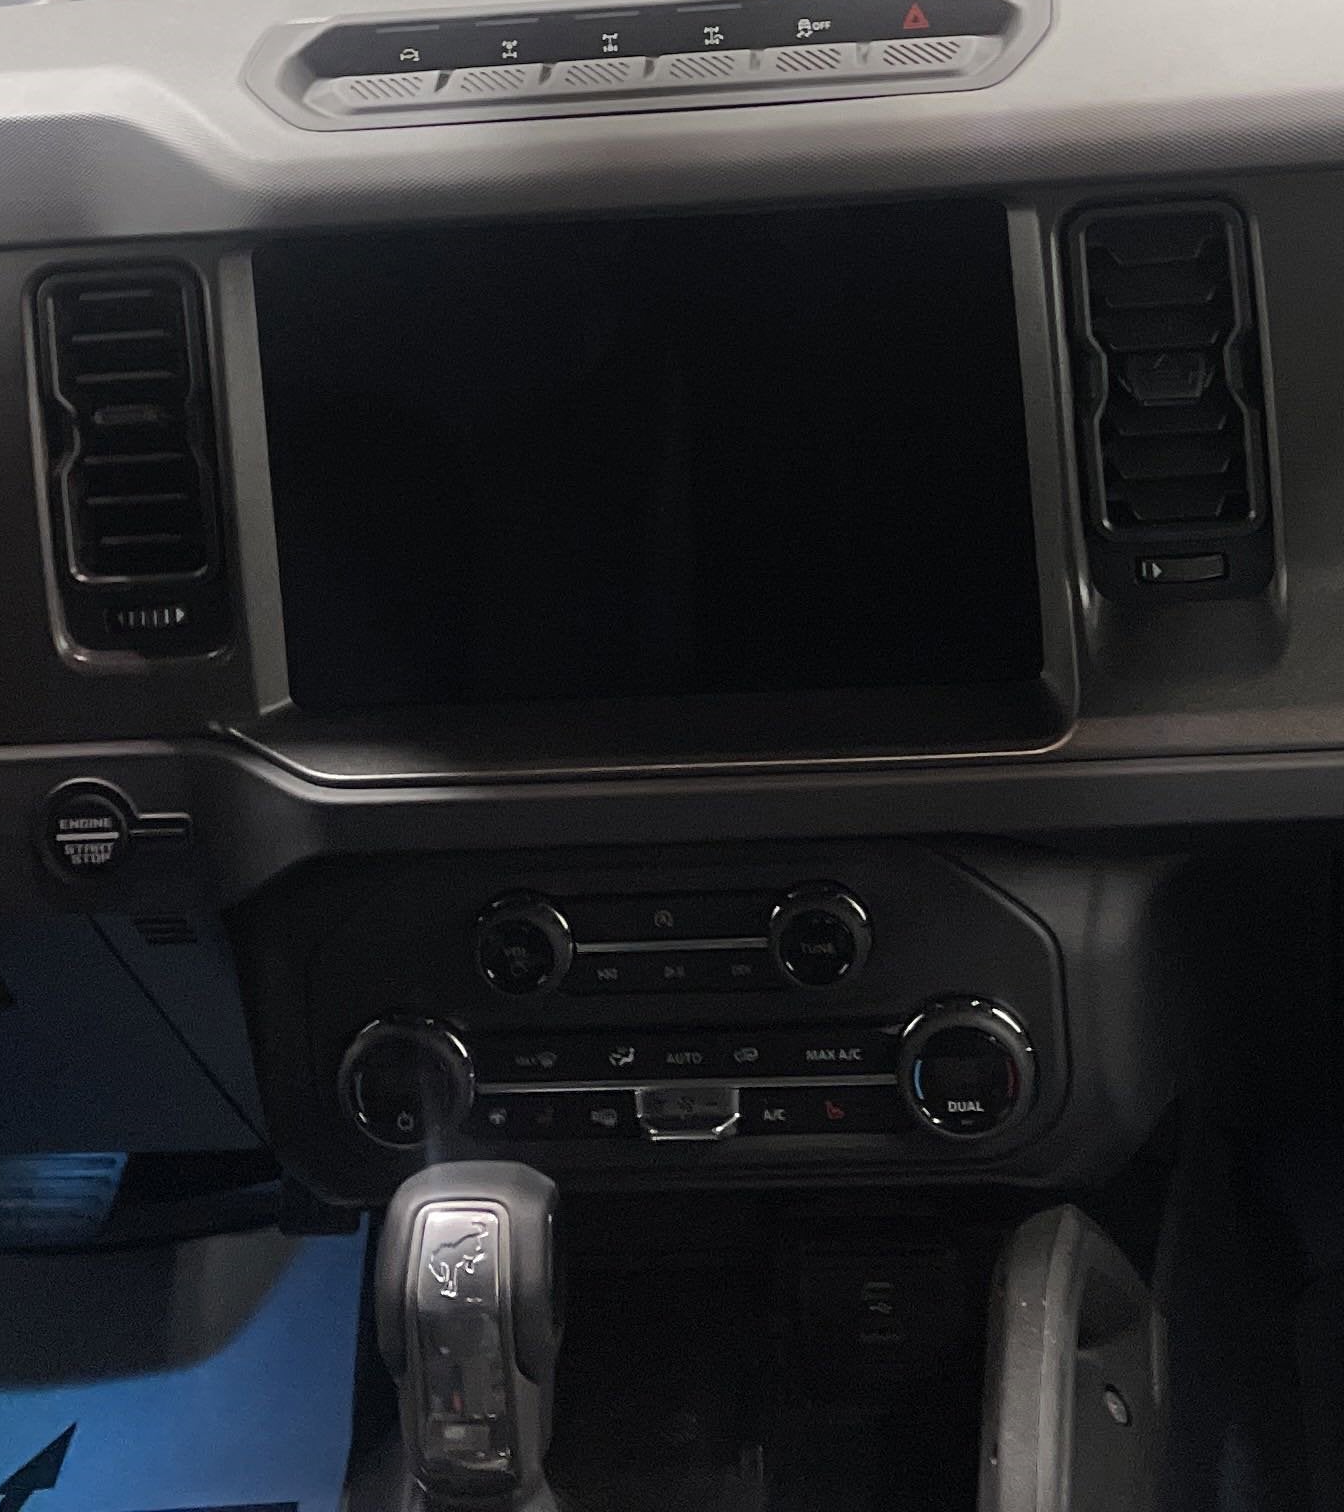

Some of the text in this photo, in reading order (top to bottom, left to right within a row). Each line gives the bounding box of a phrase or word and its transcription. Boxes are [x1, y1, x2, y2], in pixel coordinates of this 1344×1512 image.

[812, 20, 831, 31] OFF
[60, 818, 112, 829] ENGINE
[666, 1051, 702, 1065] AUTO
[806, 1046, 862, 1062] MAX A/C
[947, 1100, 985, 1114] DUAL
[763, 1108, 786, 1122] A/C
